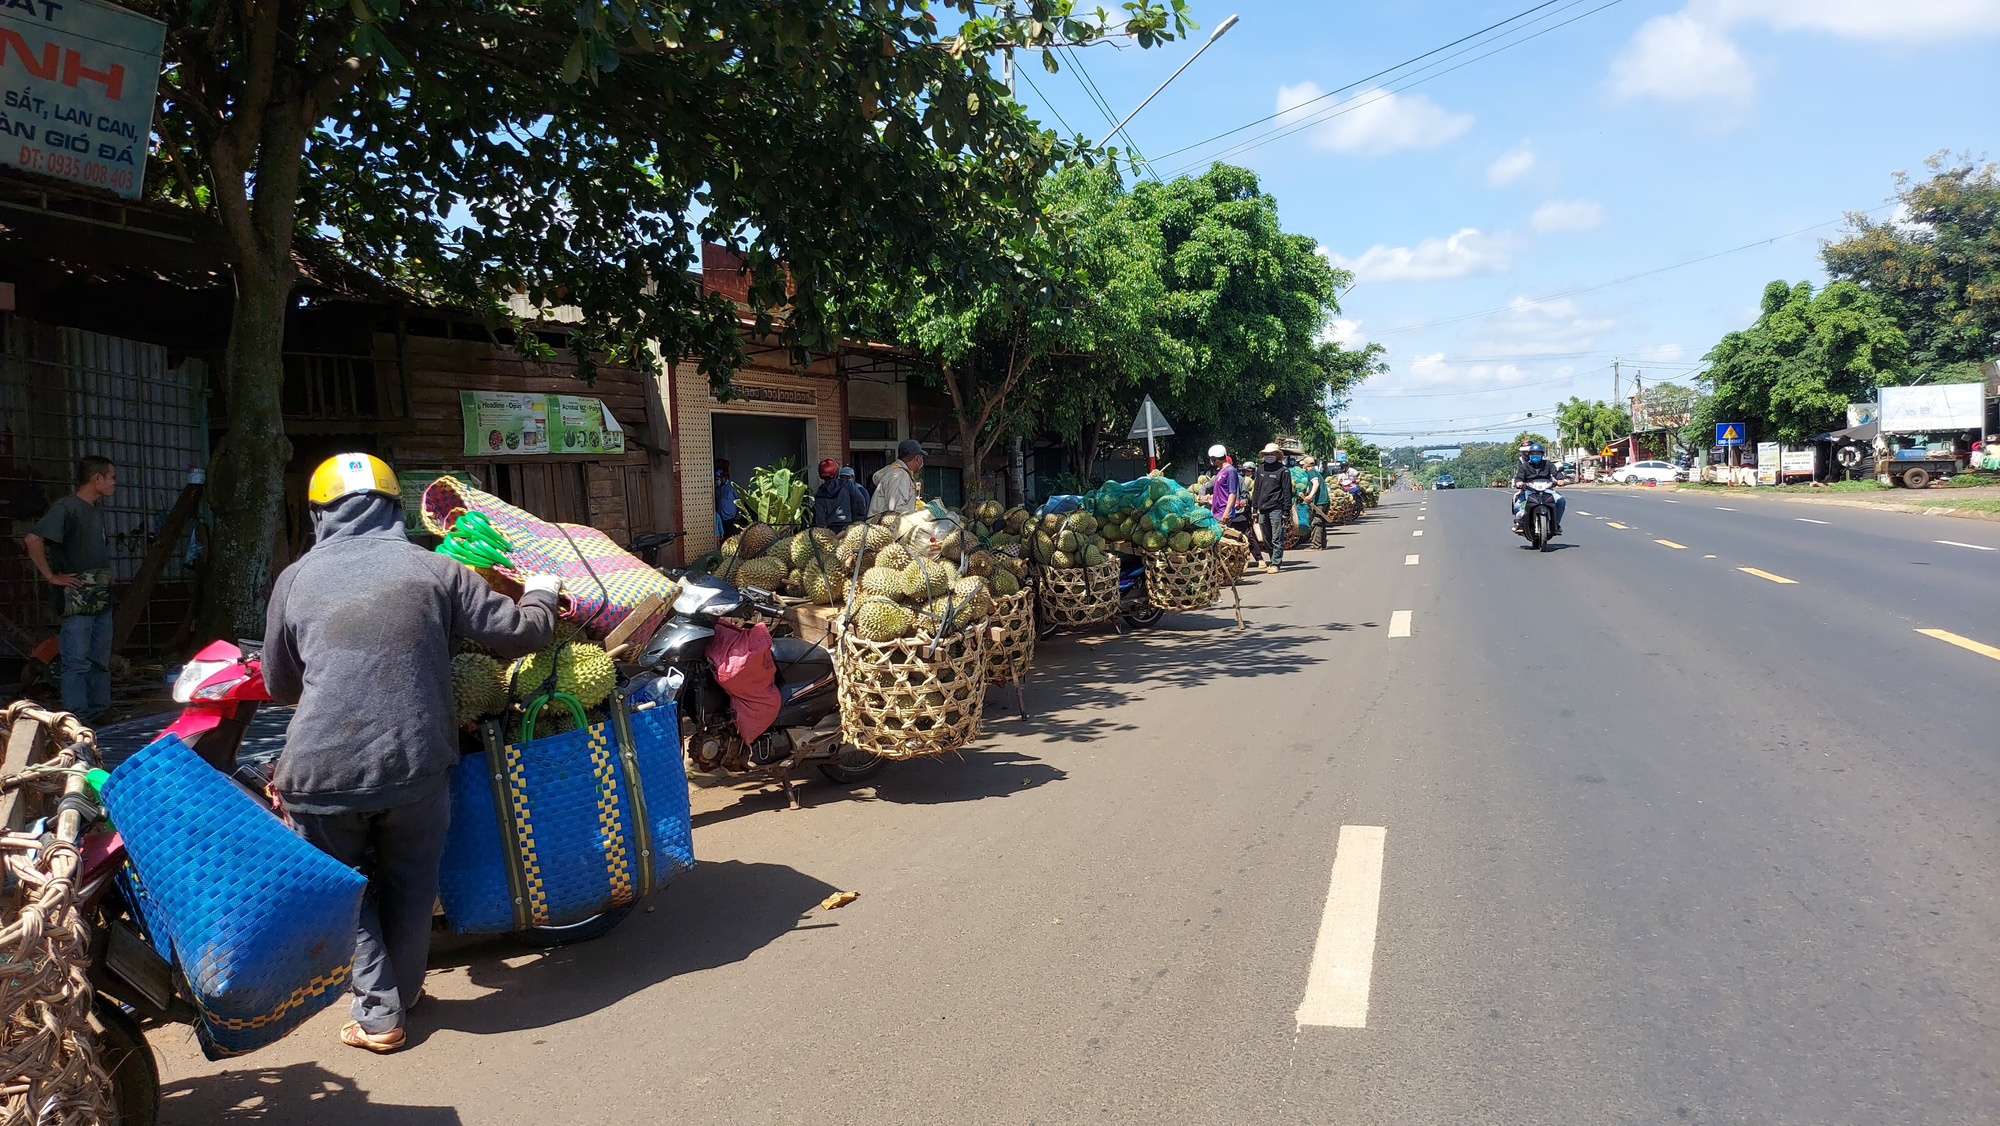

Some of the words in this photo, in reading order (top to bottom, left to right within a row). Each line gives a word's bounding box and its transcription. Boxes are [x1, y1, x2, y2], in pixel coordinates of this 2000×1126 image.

[4, 86, 48, 119] SẮT,
[54, 104, 92, 128] LAN
[97, 116, 138, 143] CAN,
[19, 145, 43, 169] ĐT:
[48, 152, 80, 178] 0935
[83, 161, 108, 184] 008
[110, 168, 134, 190] 403
[45, 132, 90, 154] GIÓ
[98, 145, 134, 165] ĐÁ
